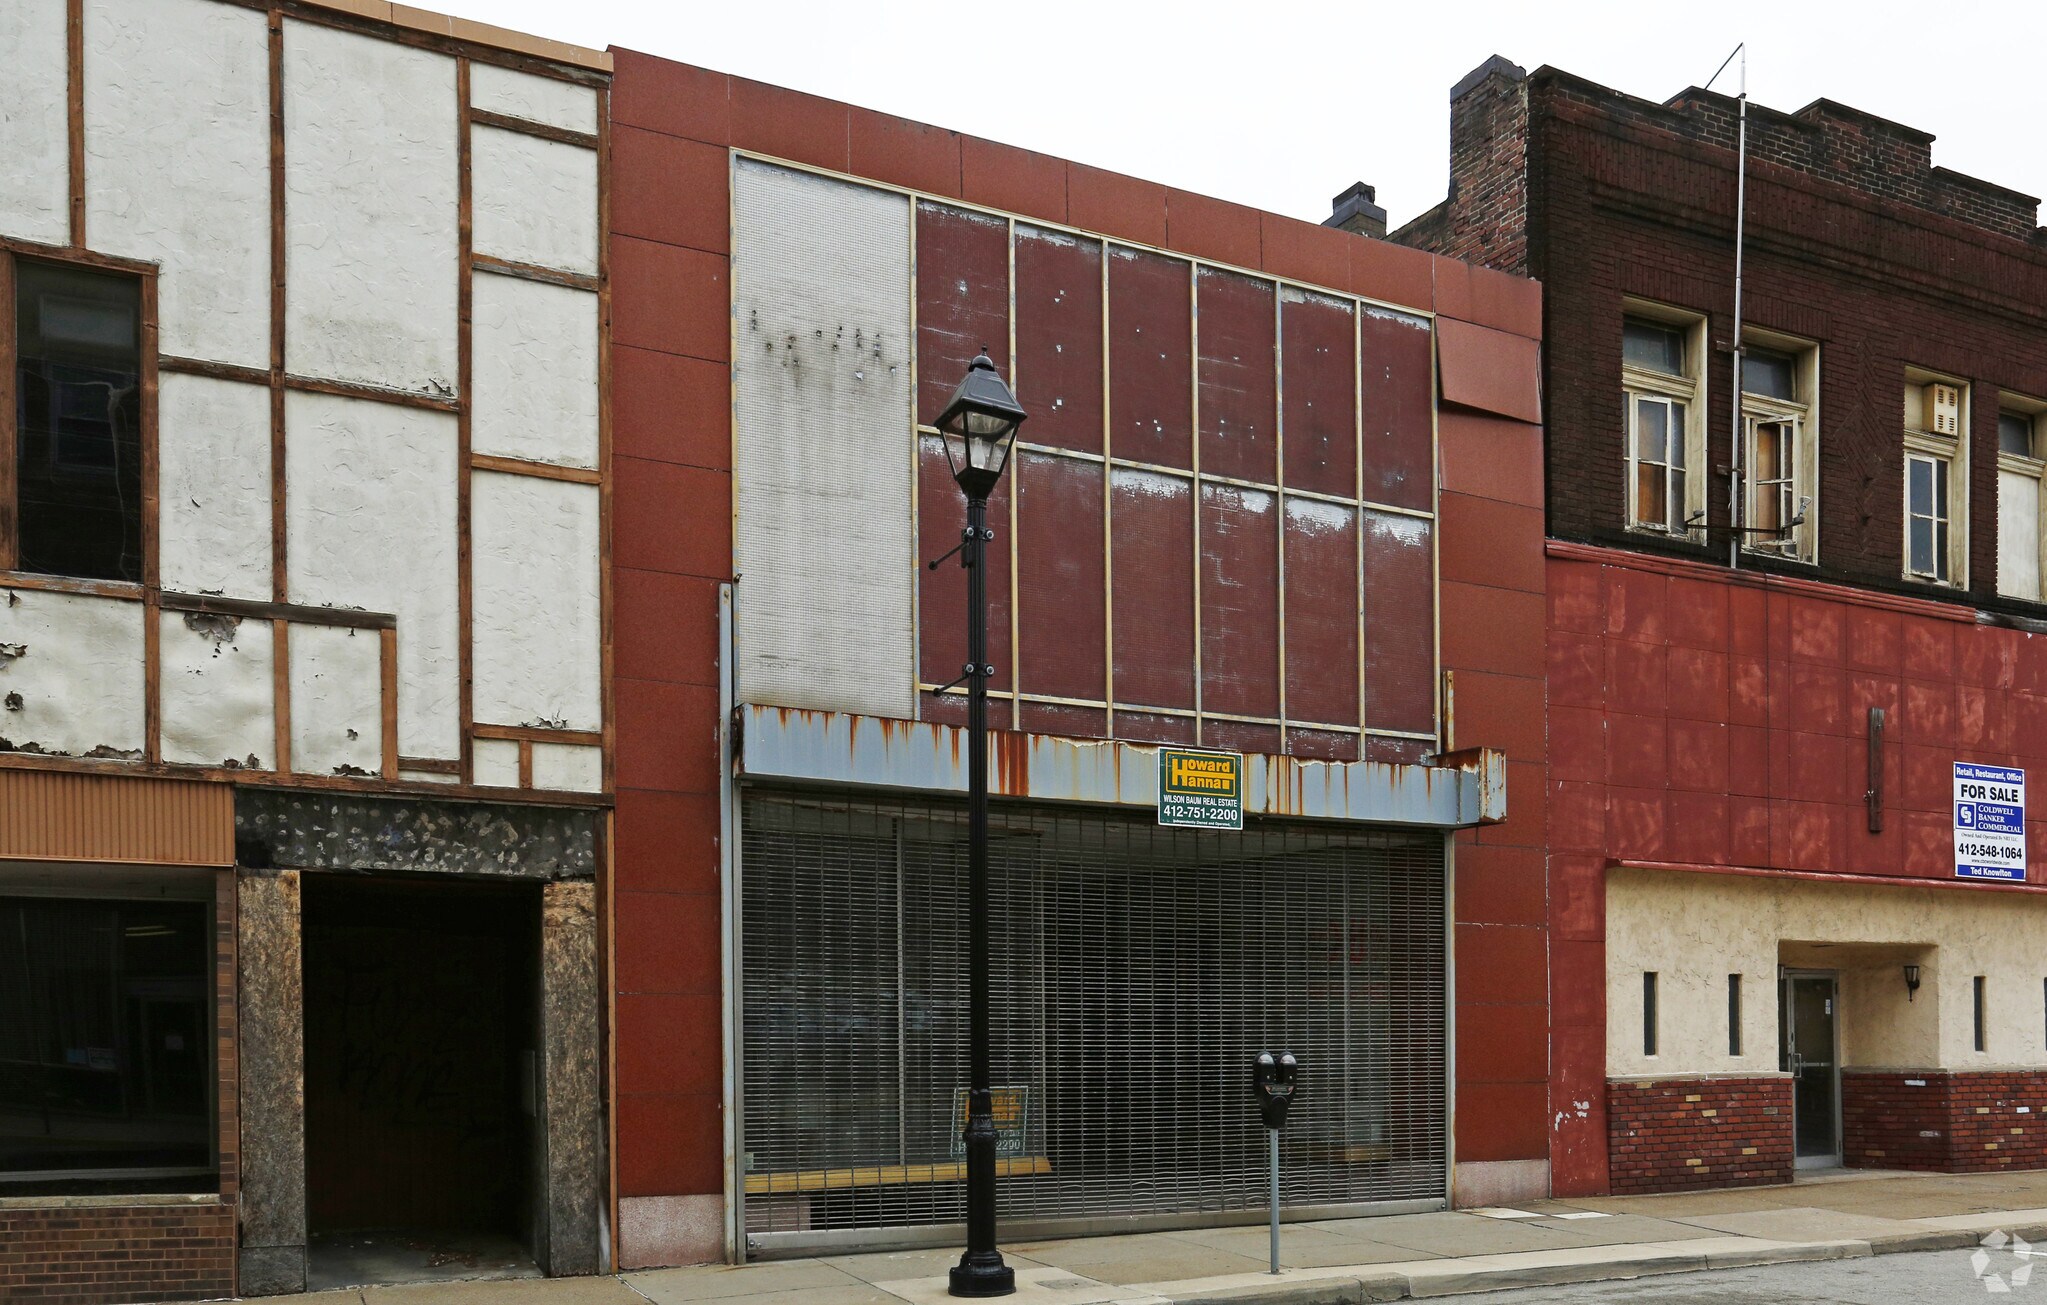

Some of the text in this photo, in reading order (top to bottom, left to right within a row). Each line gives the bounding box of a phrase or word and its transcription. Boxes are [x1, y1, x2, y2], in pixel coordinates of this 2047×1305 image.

[1172, 758, 1230, 780] Howard
[1956, 767, 2022, 782] Retail, Restaurant, Office
[1961, 784, 2018, 802] FOR SALE
[1163, 795, 1237, 807] WILSON BAUM REAL ESTATE
[1163, 805, 1238, 821] 412-751-2200
[1978, 805, 2015, 816] COLDWELL
[1978, 814, 2005, 823] BANKER
[1978, 822, 2022, 833] COMMERCIAL
[1970, 867, 2012, 878] Ted Knowlton
